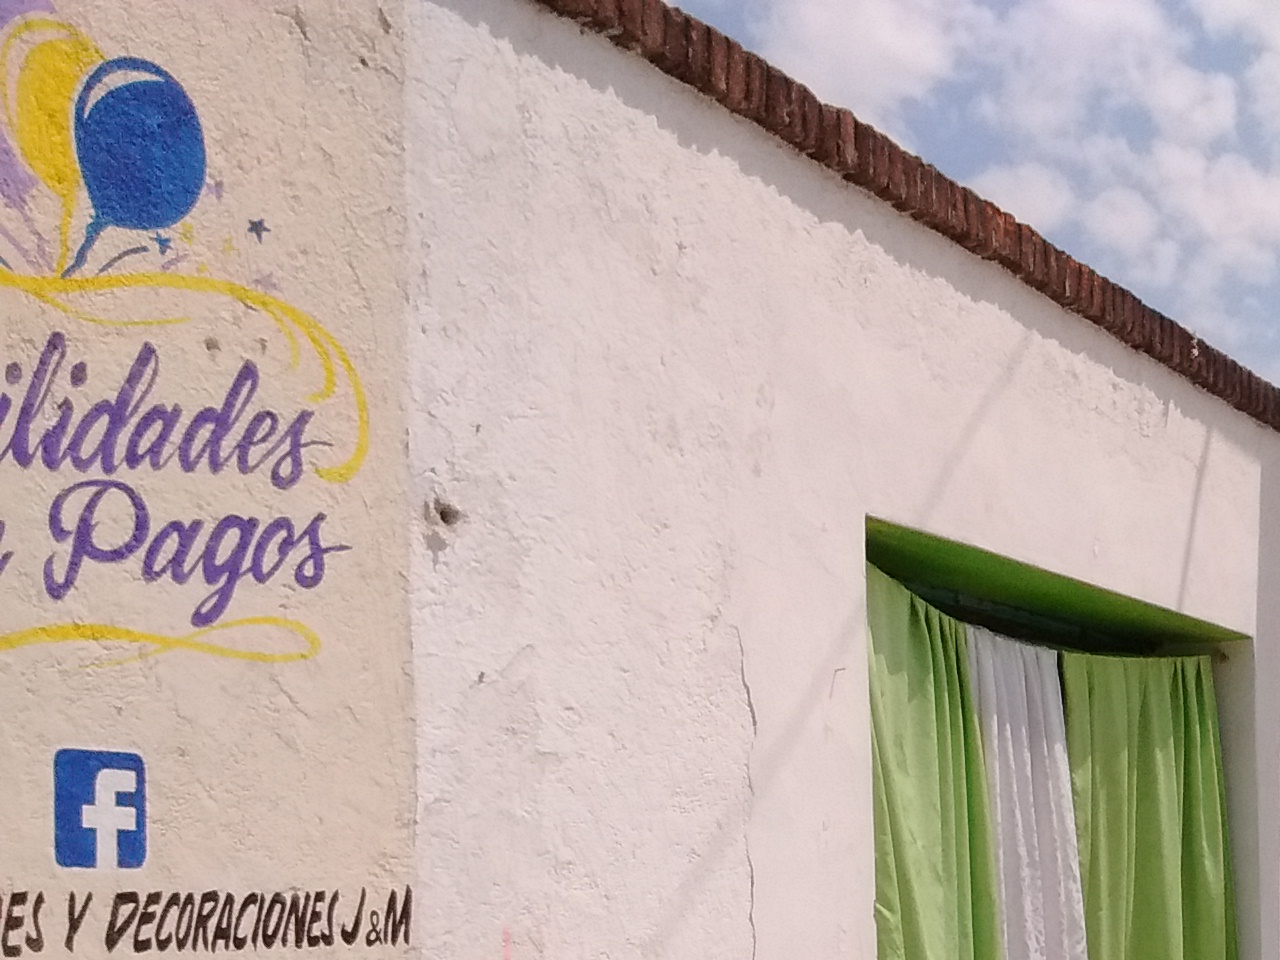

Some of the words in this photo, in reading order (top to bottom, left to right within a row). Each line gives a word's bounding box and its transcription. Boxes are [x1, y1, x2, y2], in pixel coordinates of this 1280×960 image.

[43, 479, 353, 628] Pagos
[63, 889, 94, 953] Y
[105, 885, 340, 954] DECORACIONES
